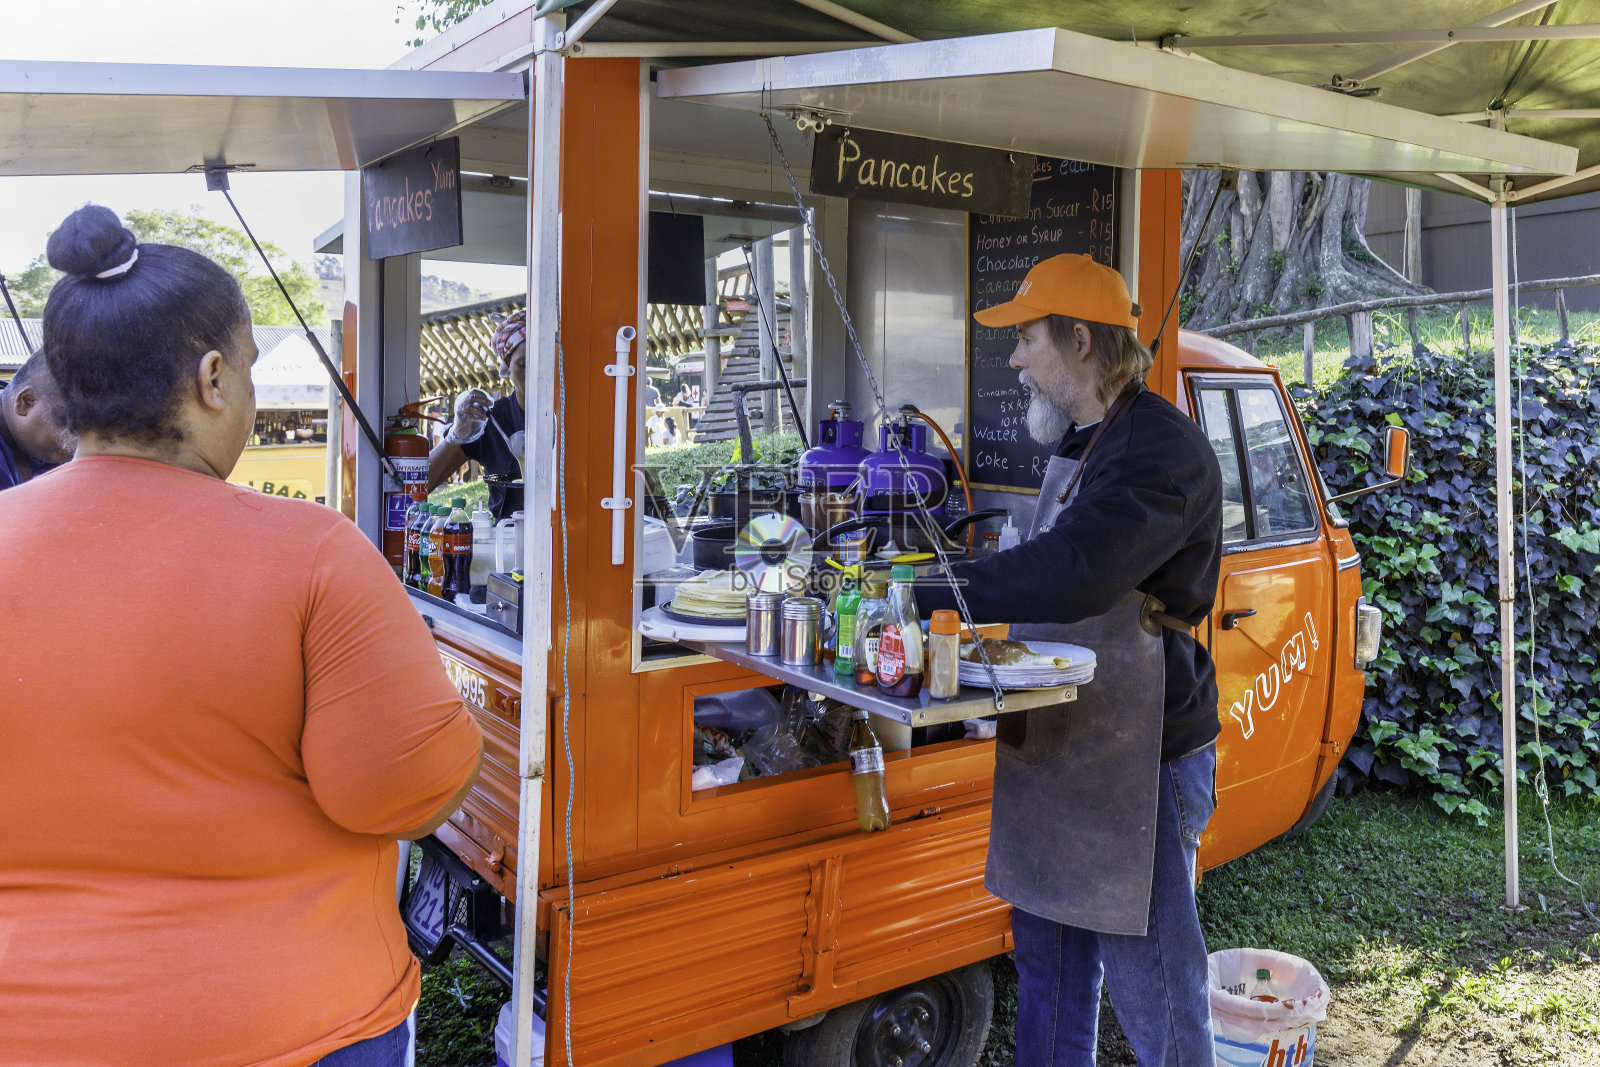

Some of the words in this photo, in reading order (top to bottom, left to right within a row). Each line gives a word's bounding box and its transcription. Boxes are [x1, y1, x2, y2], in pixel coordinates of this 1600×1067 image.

[836, 138, 974, 198] Pancakes
[1032, 156, 1052, 173] kes
[431, 160, 455, 192] Yum
[976, 233, 1012, 251] Honey
[976, 254, 1039, 273] Chocolate
[974, 347, 1011, 368] Peanu
[977, 388, 1019, 398] Cinnamon
[975, 450, 1009, 470] Coke
[1229, 611, 1320, 740] YUM!
[1266, 1034, 1308, 1067] hth
